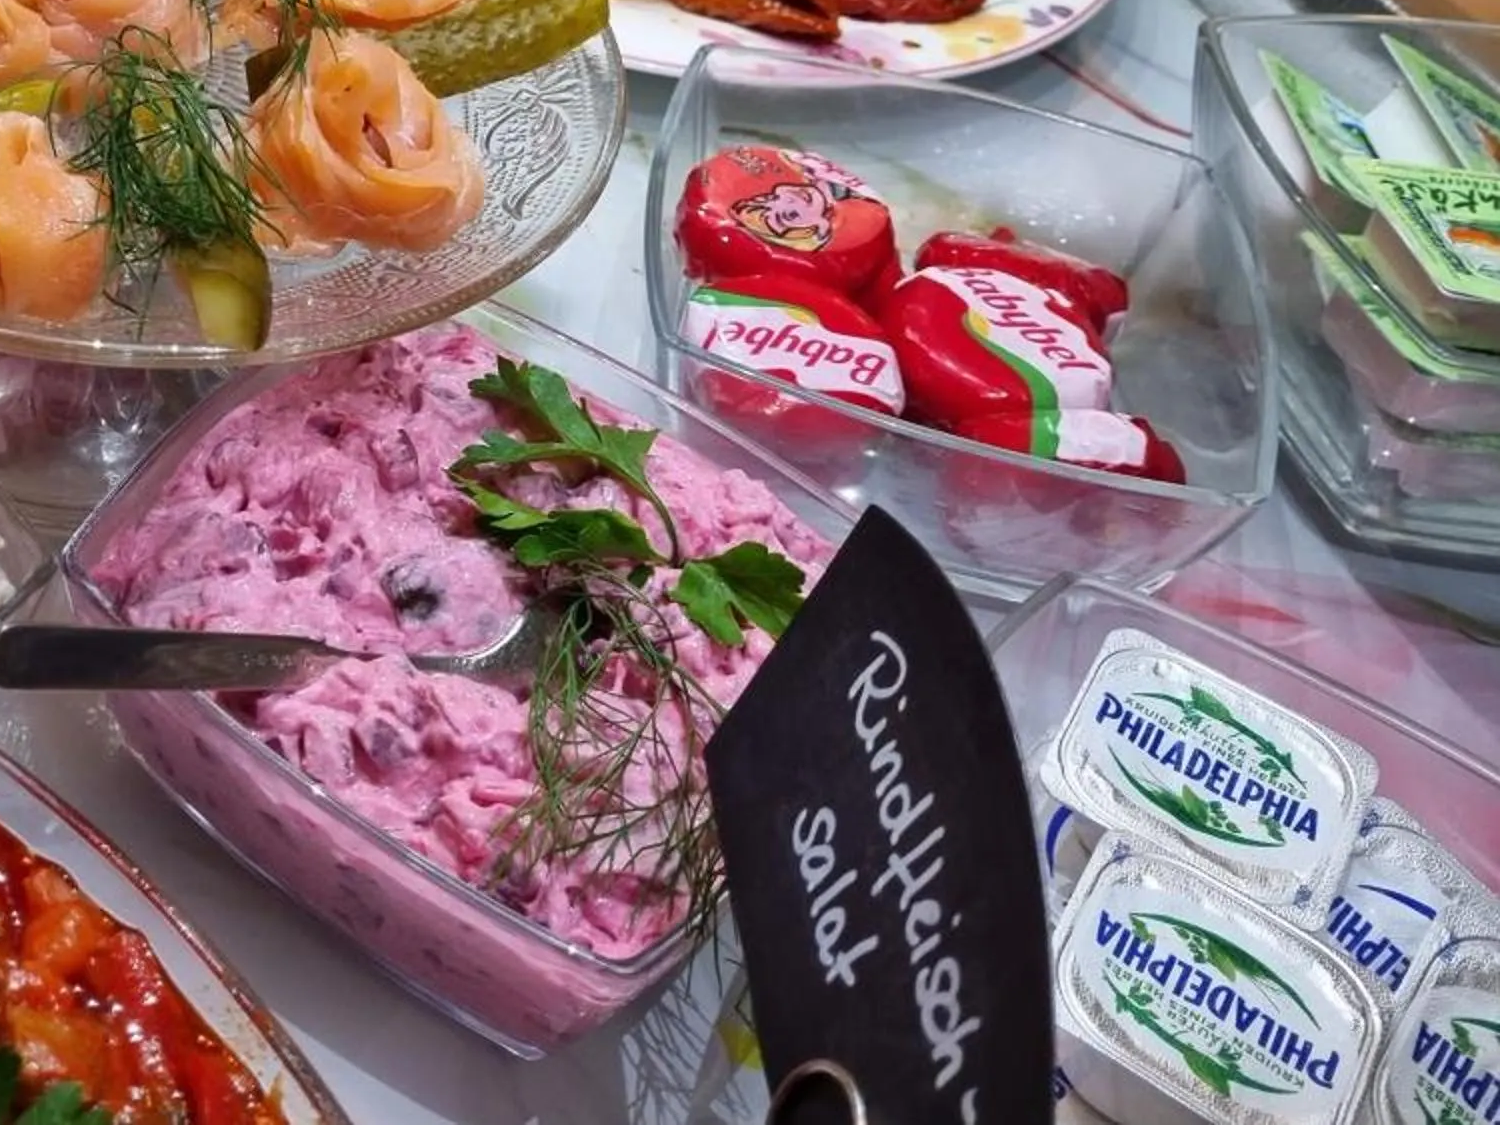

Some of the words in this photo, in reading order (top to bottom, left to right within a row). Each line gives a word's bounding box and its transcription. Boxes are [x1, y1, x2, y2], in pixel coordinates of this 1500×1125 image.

[703, 319, 888, 387] Babybel
[1095, 691, 1320, 842] PHILADELPHIA
[1096, 910, 1340, 1090] PHILADELPHIA
